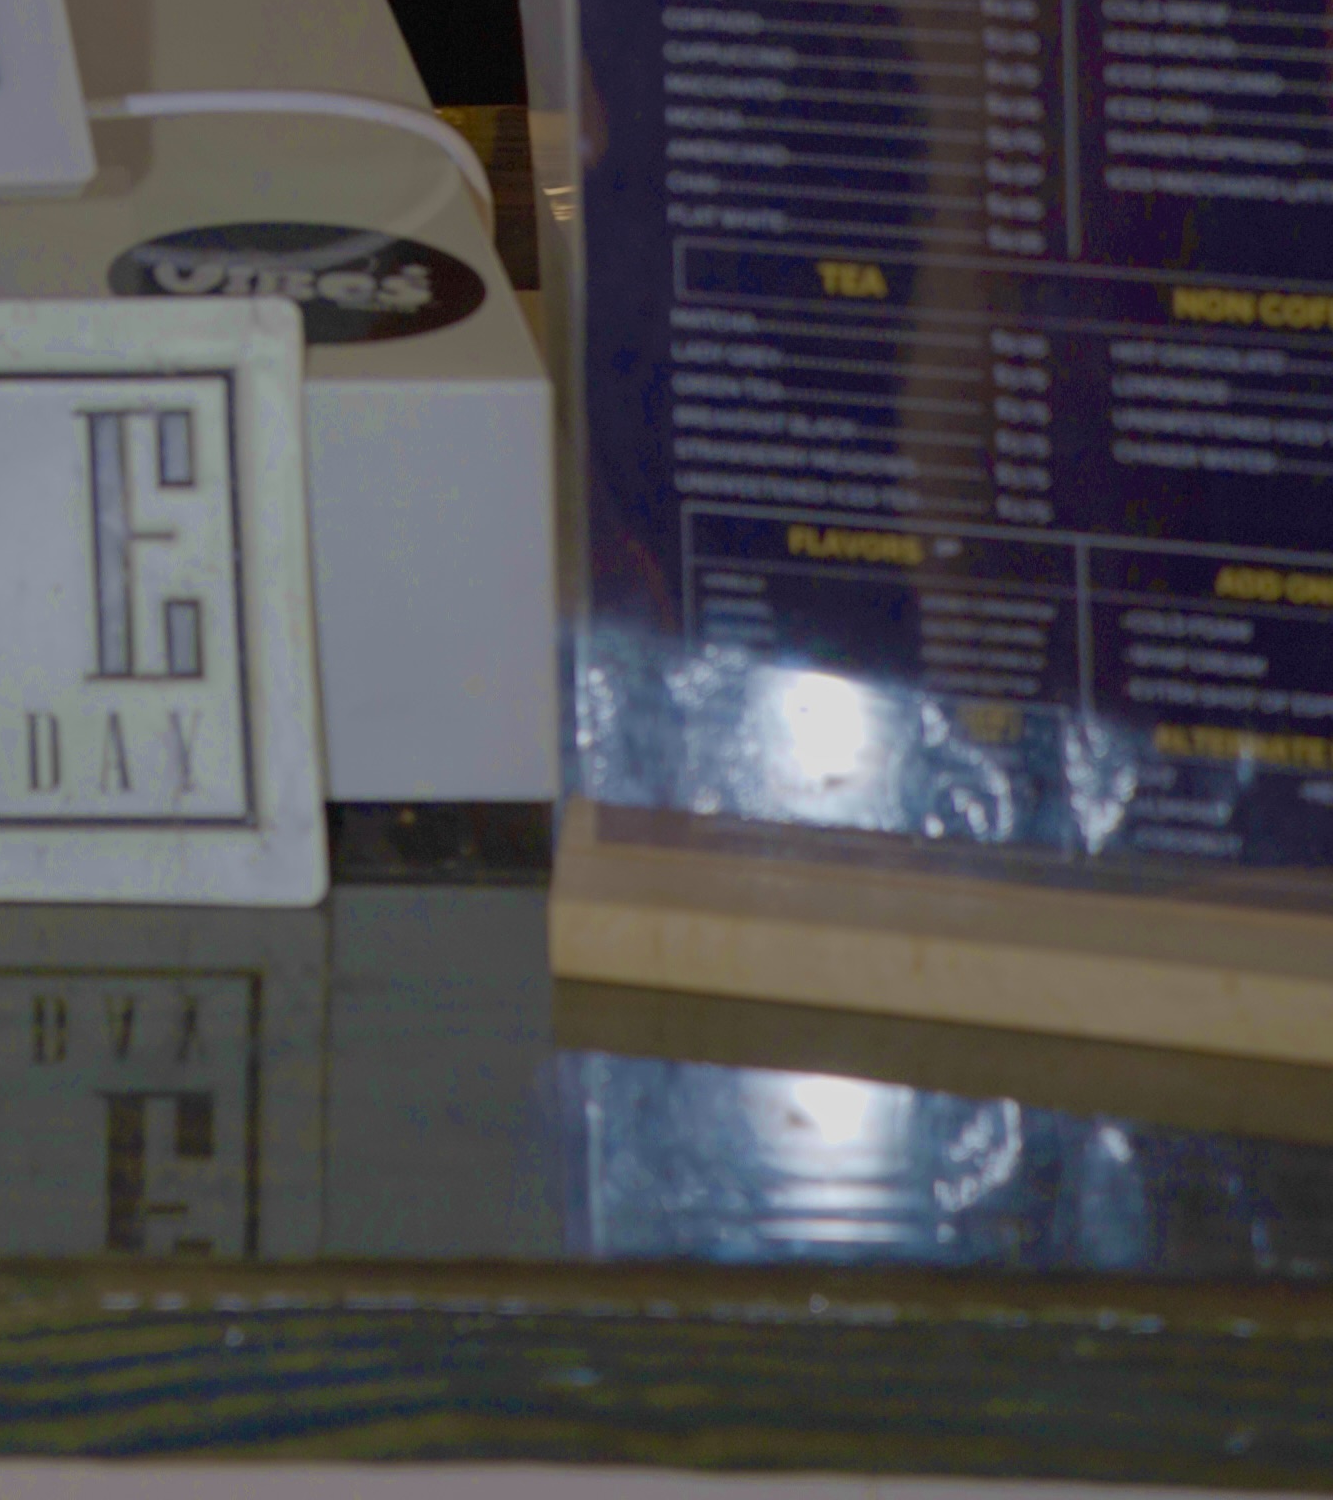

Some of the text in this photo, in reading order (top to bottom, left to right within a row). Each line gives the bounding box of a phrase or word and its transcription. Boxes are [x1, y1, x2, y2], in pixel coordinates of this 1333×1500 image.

[815, 259, 889, 299] TEA
[1173, 286, 1256, 324] NON
[787, 523, 925, 567] FLAVORS
[25, 710, 201, 794] DAY
